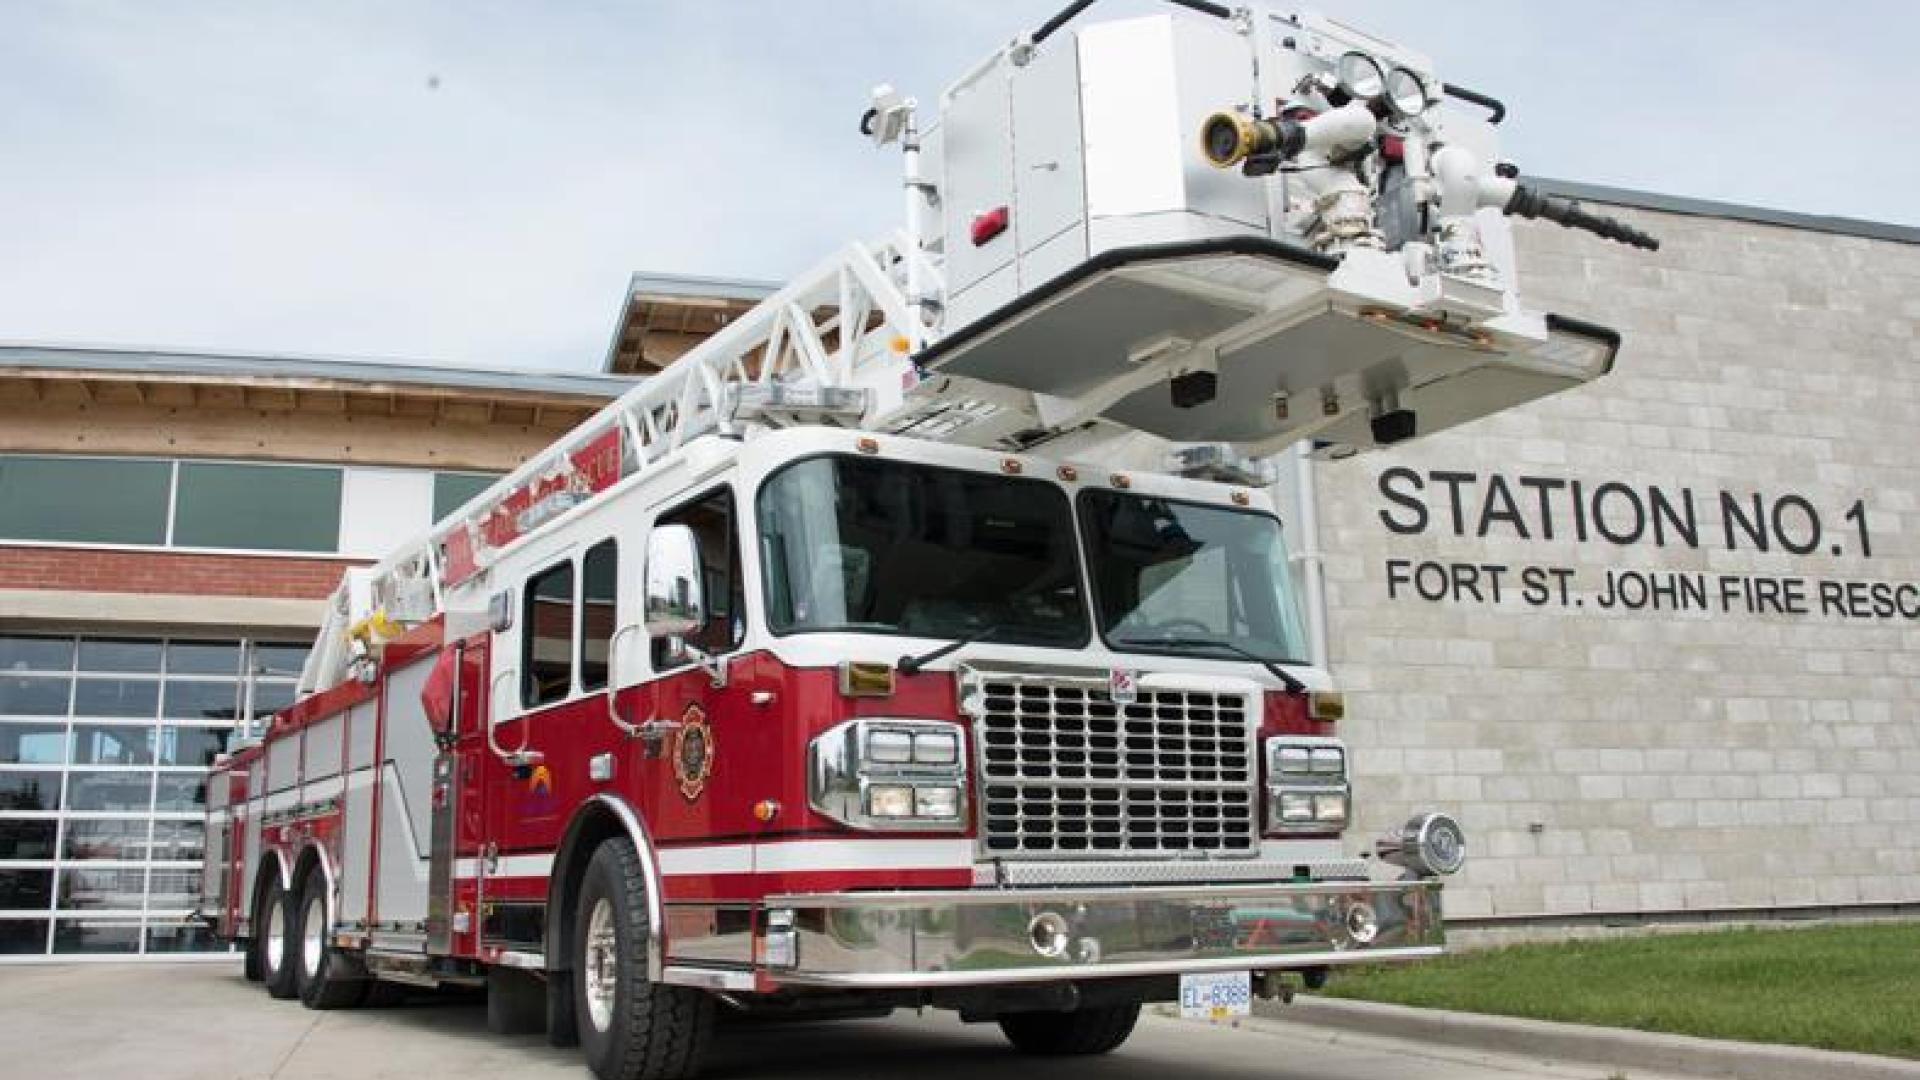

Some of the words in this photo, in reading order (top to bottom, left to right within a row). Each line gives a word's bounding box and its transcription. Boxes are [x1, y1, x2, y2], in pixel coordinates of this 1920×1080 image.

[1378, 466, 1699, 550] STATION
[1719, 490, 1872, 558] NO.1
[1385, 559, 1508, 604] FORT
[1521, 565, 1583, 607] ST.
[1597, 570, 1708, 611] JOHN
[1719, 575, 1809, 615] FIRE
[1819, 580, 1920, 620] RESC
